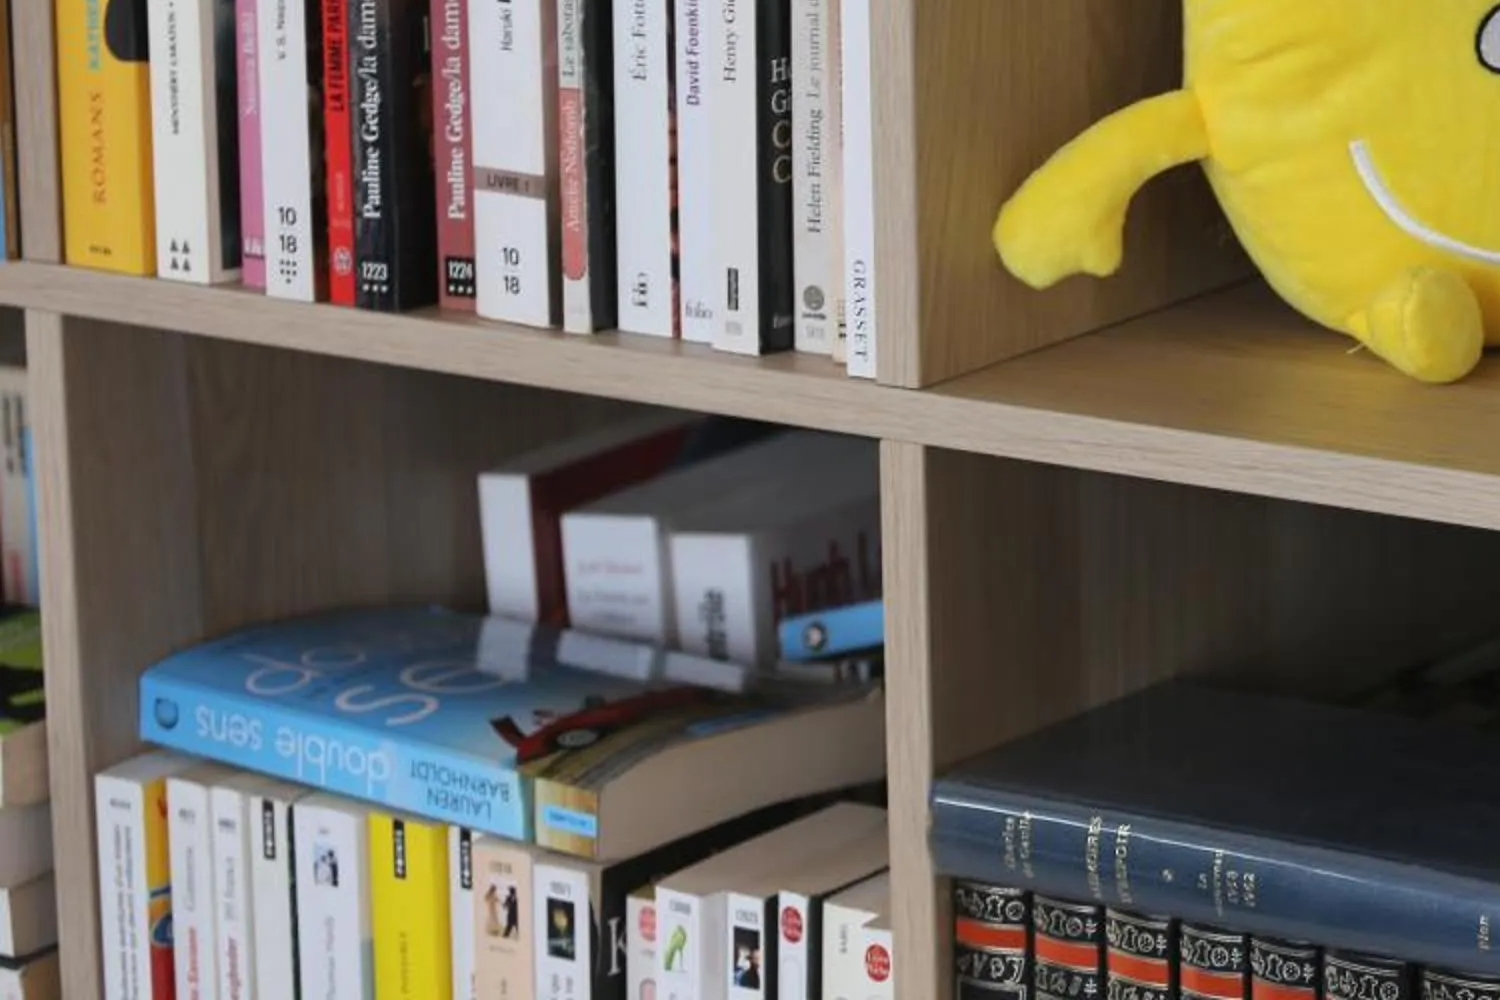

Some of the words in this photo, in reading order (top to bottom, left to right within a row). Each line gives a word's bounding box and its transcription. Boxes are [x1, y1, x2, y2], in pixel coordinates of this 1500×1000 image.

[326, 38, 344, 90] FEMME
[722, 30, 741, 84] Henry
[804, 13, 825, 73] journal
[561, 57, 576, 78] Le
[685, 60, 701, 107] David
[806, 81, 820, 100] Le
[328, 93, 344, 112] LA
[357, 55, 382, 143] Gedge/la
[440, 55, 465, 143] Gedge/la
[88, 90, 107, 205] ROMANS
[805, 108, 825, 178] Fielding
[362, 146, 382, 219] Pauline
[446, 146, 467, 220] Pauline
[486, 175, 519, 192] LIVRE
[280, 207, 296, 226] 10
[806, 183, 822, 234] Helen
[280, 236, 297, 254] 18
[503, 248, 520, 266] 10
[363, 262, 389, 281] 1223
[449, 260, 474, 280] 1224
[503, 276, 521, 296] 18
[851, 260, 867, 360] GRASSET
[194, 703, 265, 753] sens
[274, 730, 394, 796] double
[410, 756, 512, 803] BARNHOLDT
[426, 790, 495, 821] LAUREN
